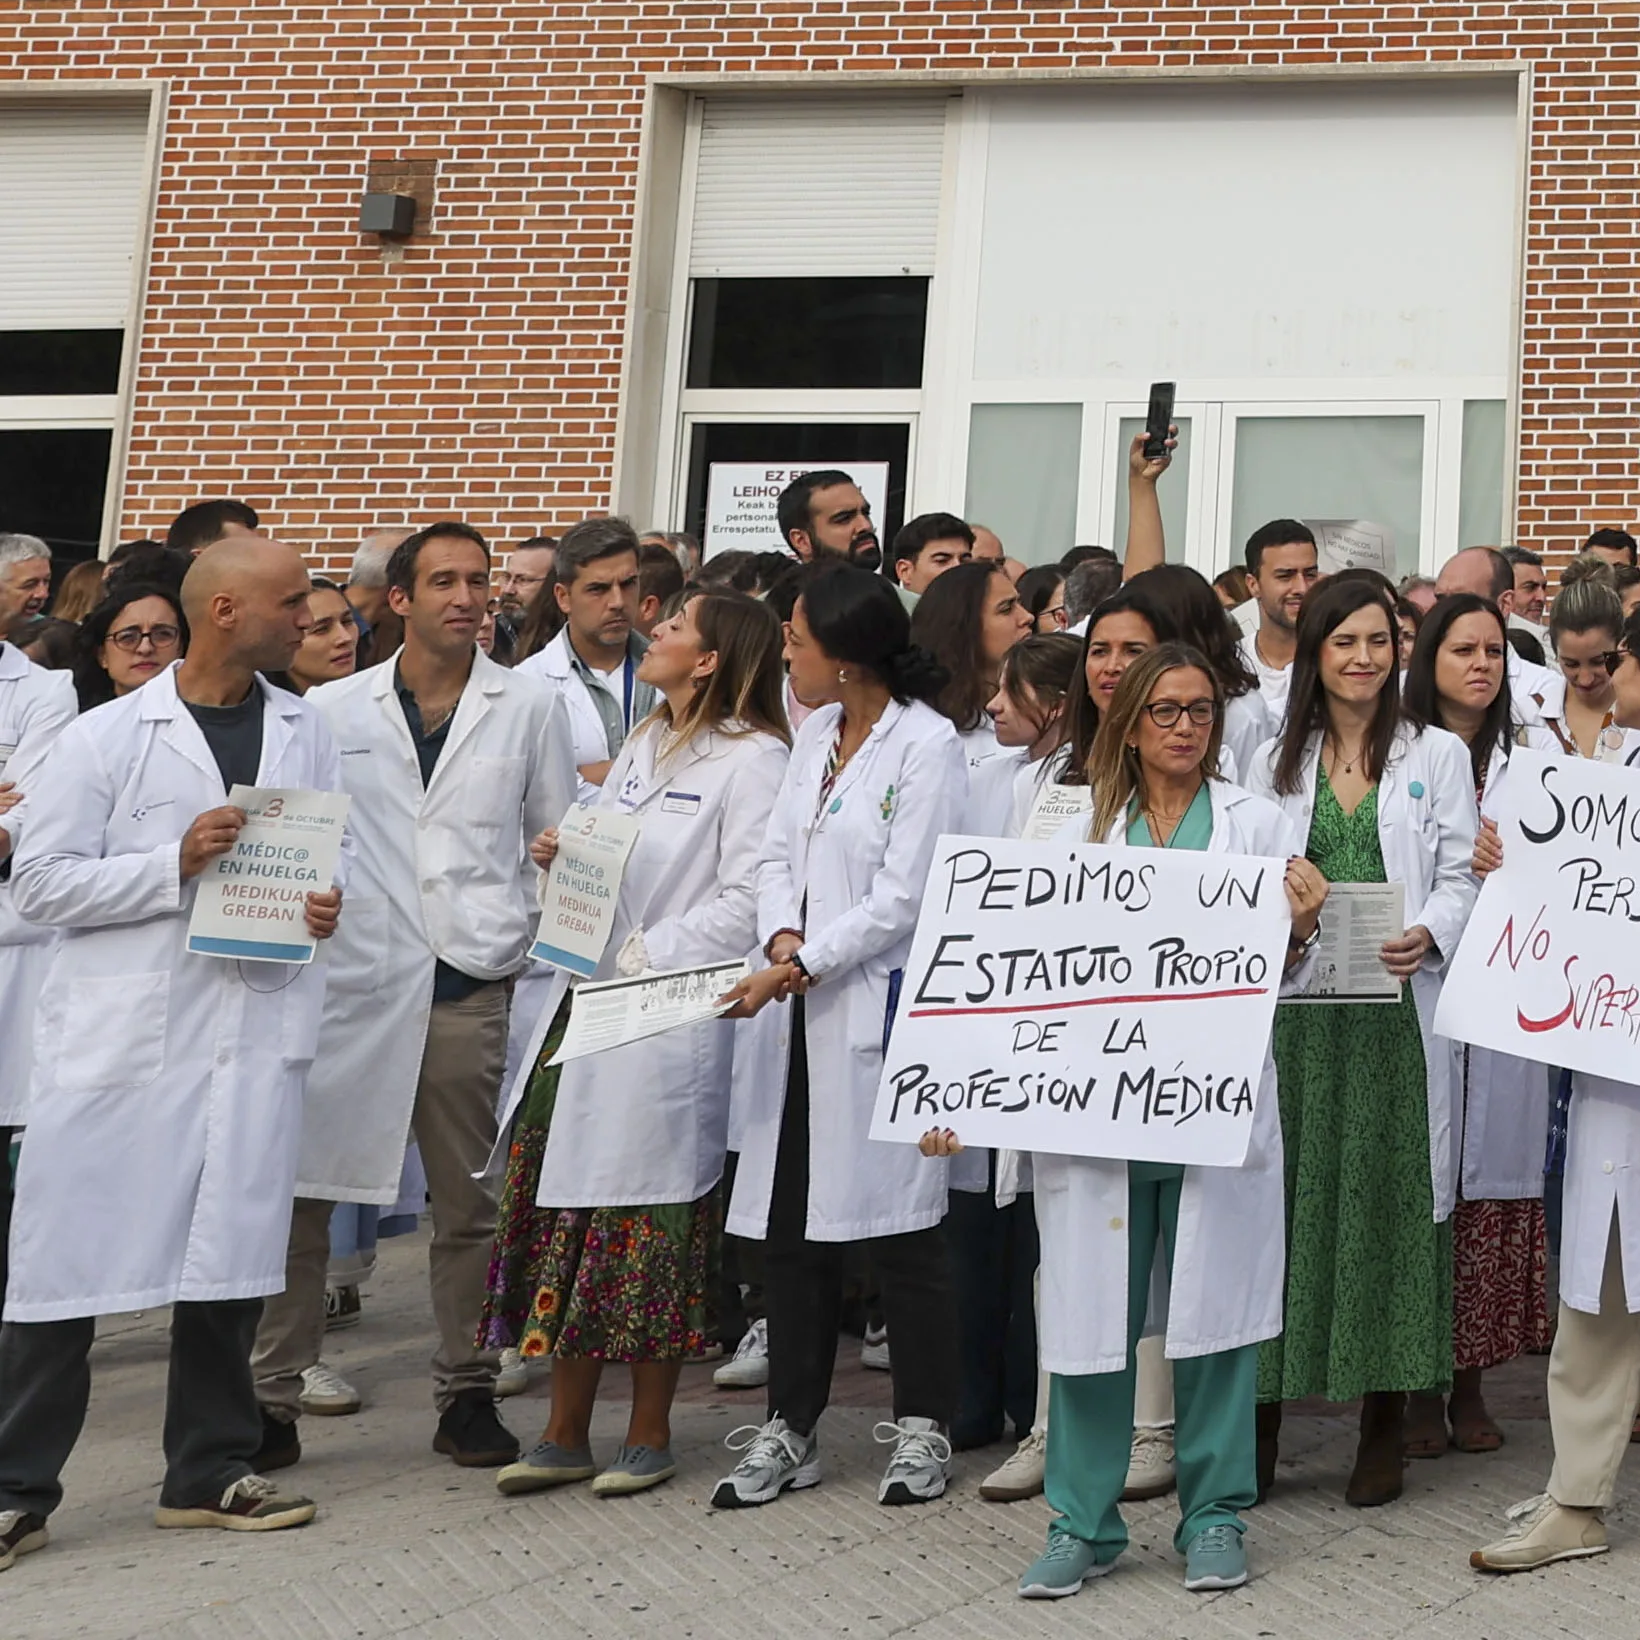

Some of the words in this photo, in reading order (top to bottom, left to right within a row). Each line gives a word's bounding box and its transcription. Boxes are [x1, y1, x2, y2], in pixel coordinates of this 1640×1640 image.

[765, 470, 785, 482] EZ
[737, 501, 765, 509] Keak
[712, 525, 776, 535] Errespetatu
[1045, 790, 1061, 804] 3
[262, 798, 285, 818] 3
[295, 816, 336, 826] OCTUBRE
[1037, 805, 1080, 815] HUELGA
[580, 817, 597, 836] 3
[237, 841, 309, 863] MÉDIC@
[218, 860, 243, 874] EN
[247, 862, 318, 882] HUELGA
[565, 856, 605, 880] MÉDIC@
[221, 883, 304, 903] MEDIKUA
[556, 871, 570, 886] EN
[571, 875, 611, 901] HUELGA
[1198, 867, 1266, 909] UN
[222, 903, 296, 921] GREBAN
[557, 894, 602, 919] MEDIKUA
[556, 914, 595, 936] GREBAN
[1486, 904, 1551, 972] NO
[913, 933, 1132, 1005] ESTATUTO
[1012, 1019, 1069, 1056] DE
[1102, 1017, 1148, 1054] LA
